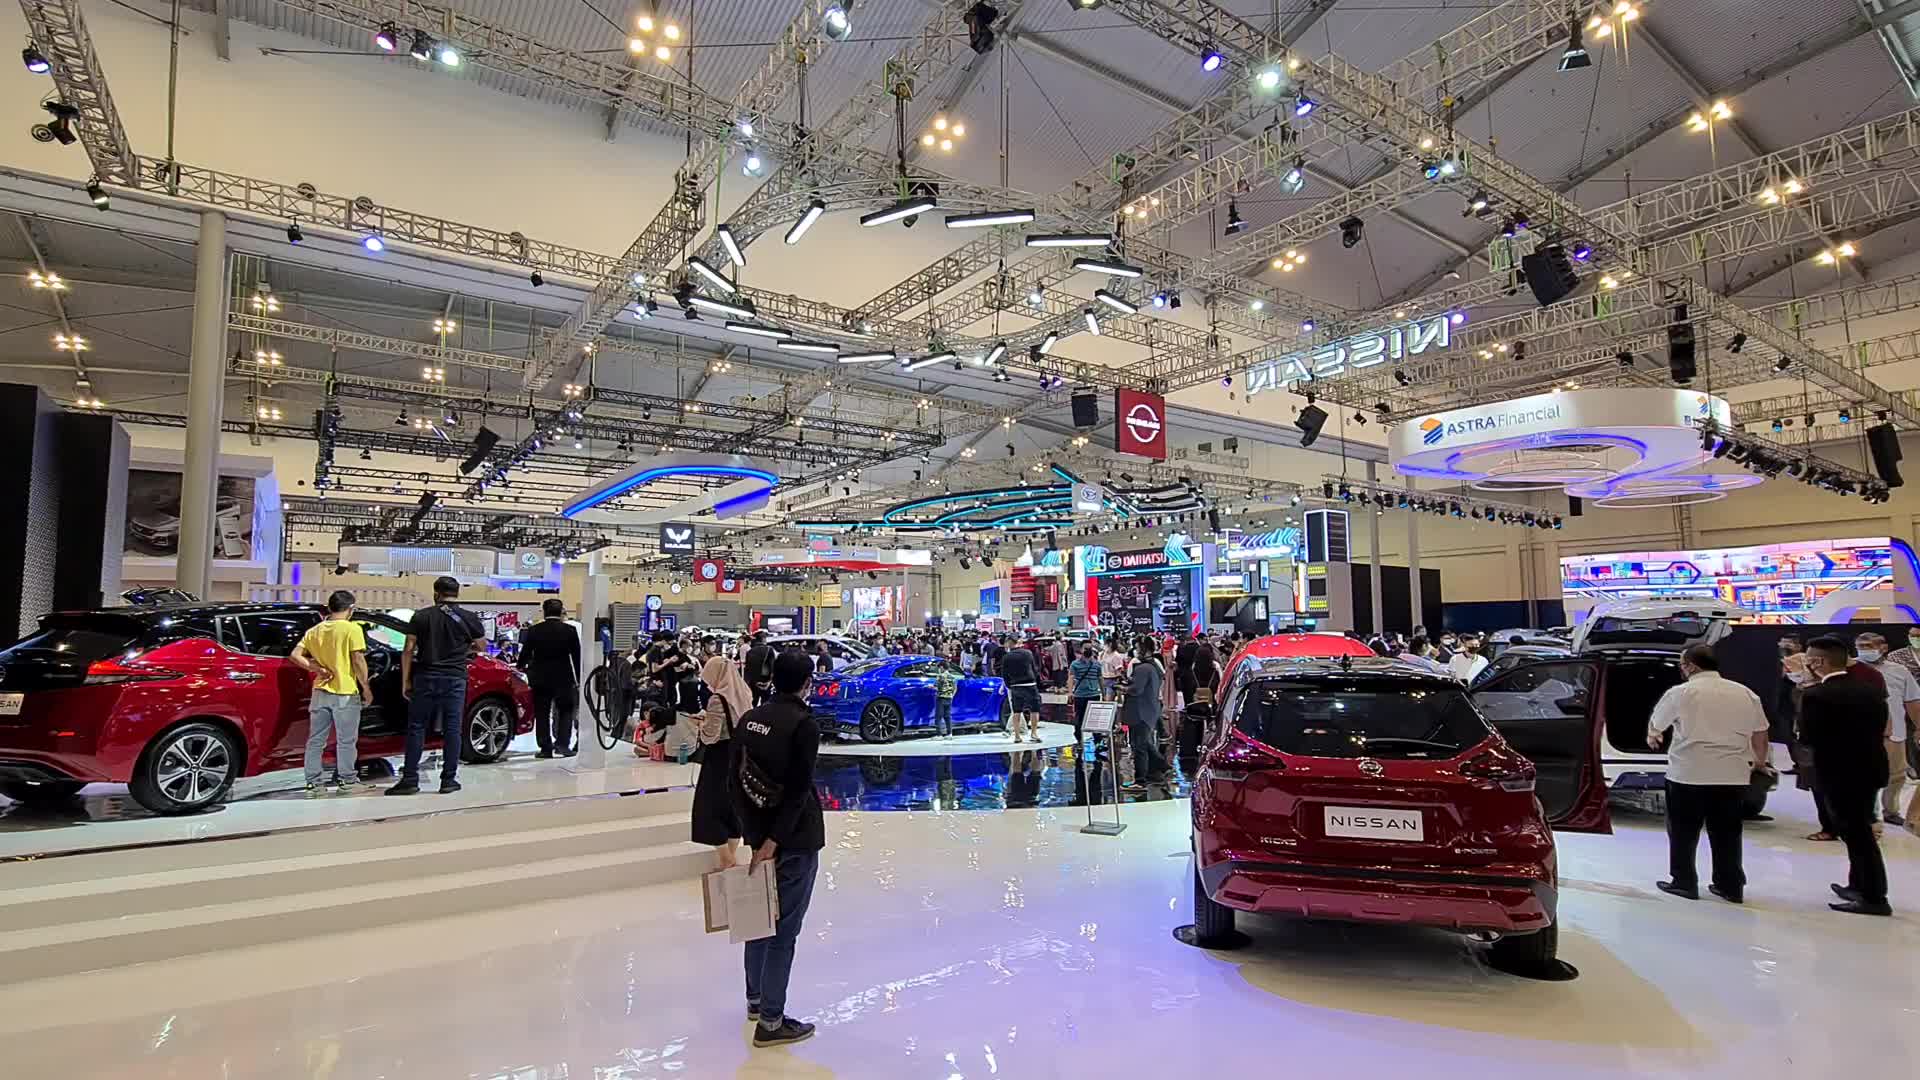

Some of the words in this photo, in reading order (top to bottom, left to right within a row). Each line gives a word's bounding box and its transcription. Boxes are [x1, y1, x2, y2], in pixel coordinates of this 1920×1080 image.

[1447, 416, 1496, 436] ASTRA
[1498, 405, 1560, 427] Financial
[1123, 553, 1167, 566] DAIHATSU
[747, 721, 771, 735] CREW
[1331, 816, 1416, 830] NISSAN
